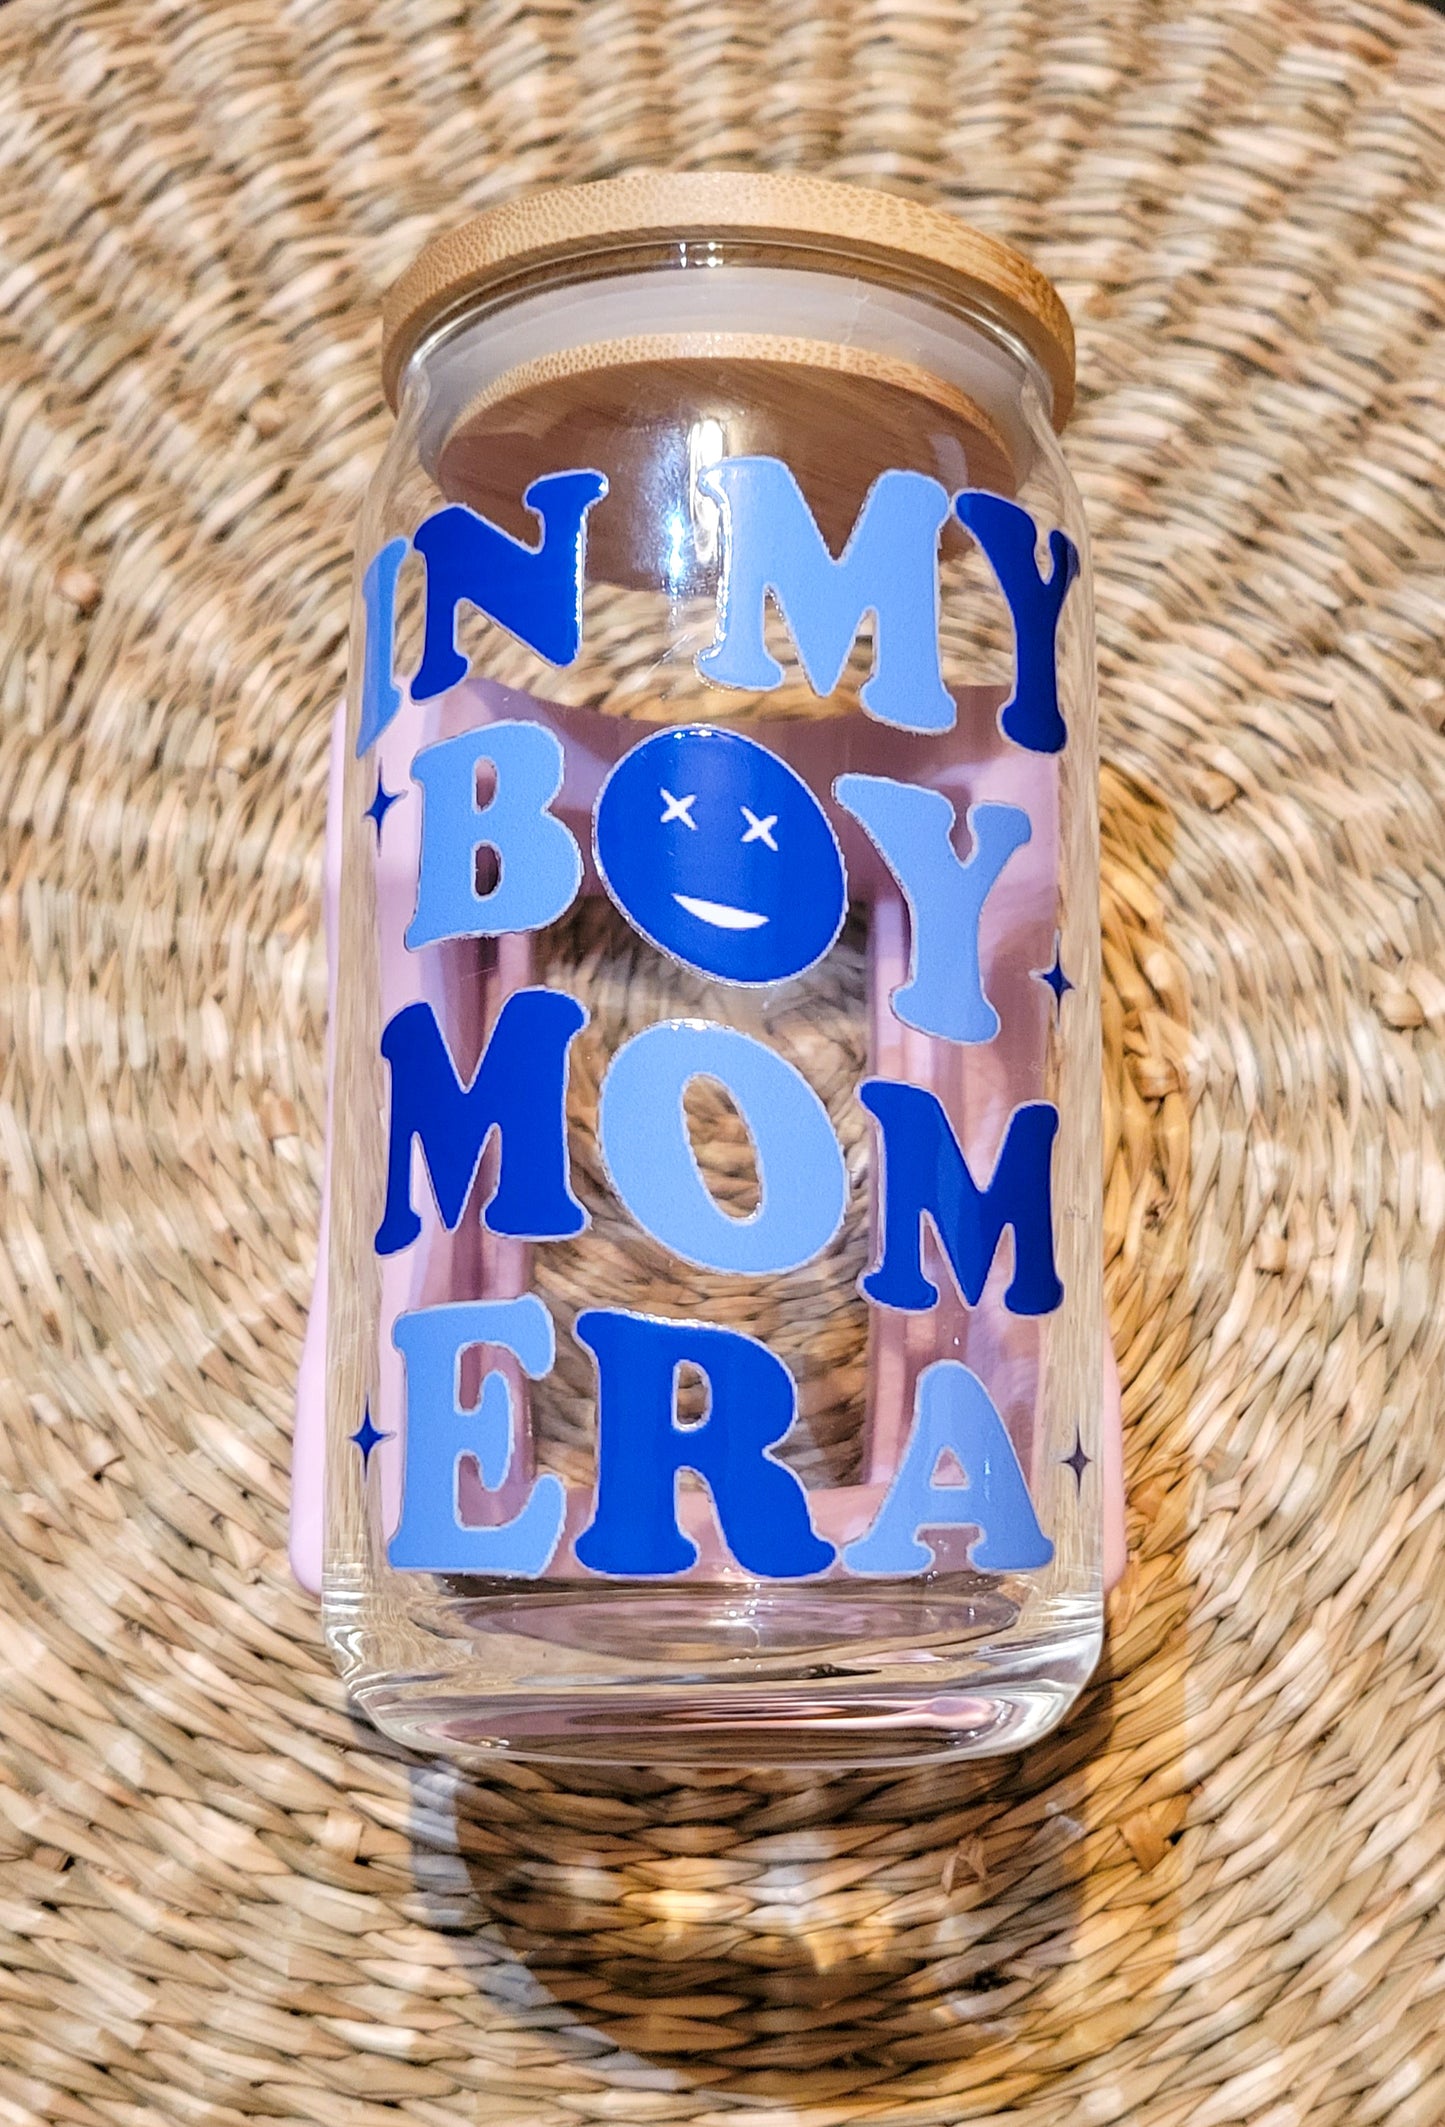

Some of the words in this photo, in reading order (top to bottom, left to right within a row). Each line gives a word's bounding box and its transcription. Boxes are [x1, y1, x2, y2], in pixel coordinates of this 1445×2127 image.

[357, 468, 608, 757] IN
[694, 456, 1081, 754] MY
[404, 719, 1032, 1044] BOY
[375, 987, 1064, 1316] MOM
[387, 1294, 1054, 1580] ERA
